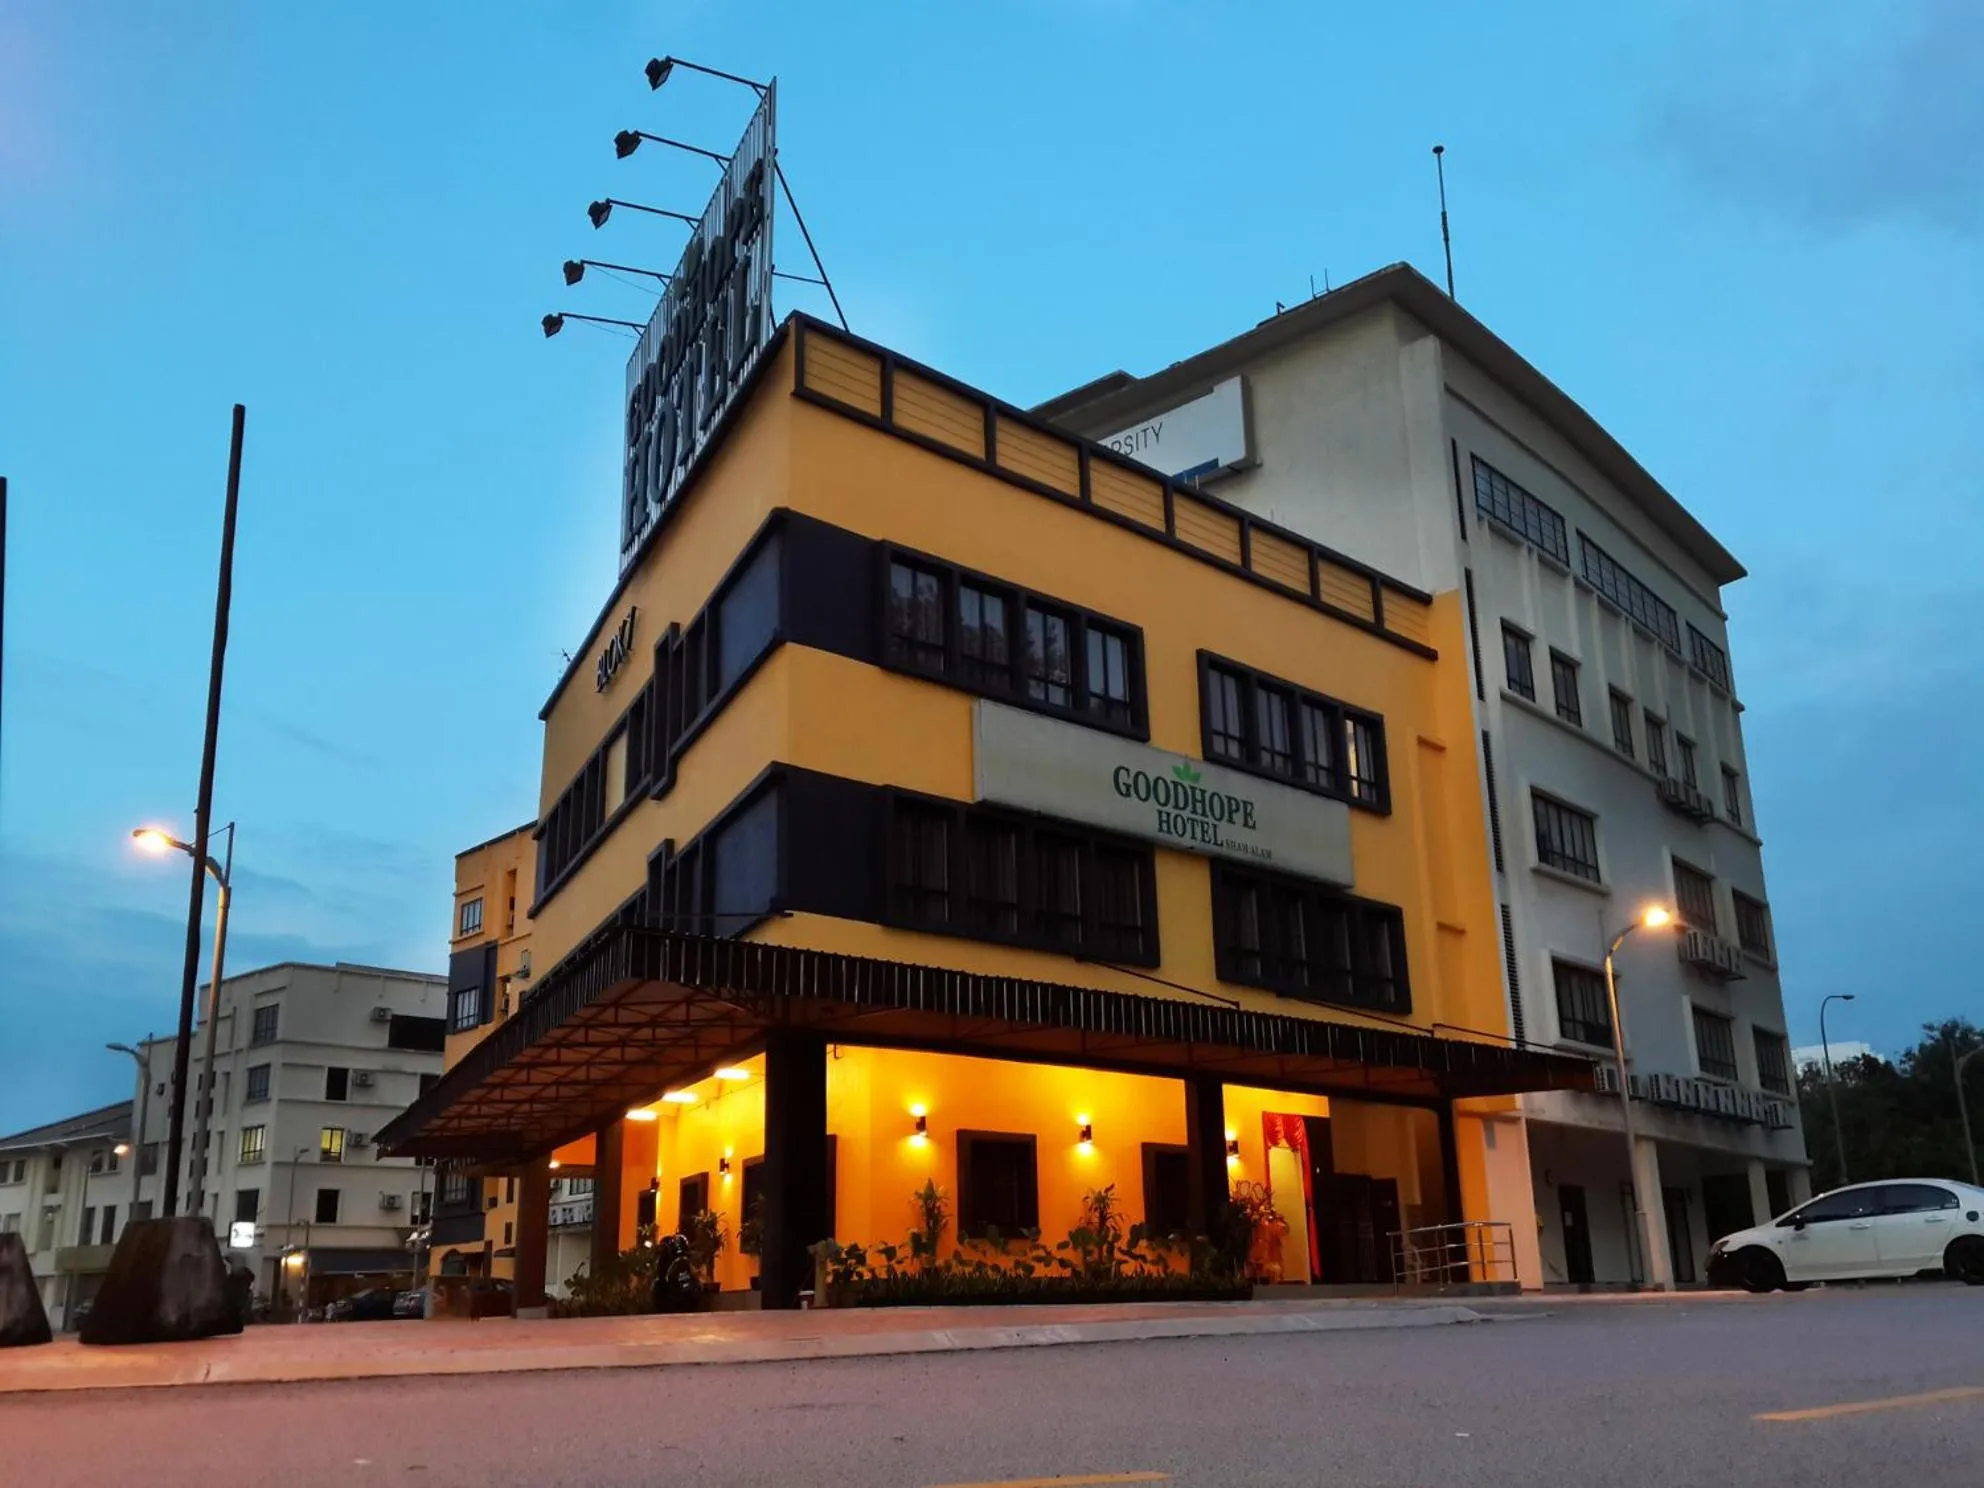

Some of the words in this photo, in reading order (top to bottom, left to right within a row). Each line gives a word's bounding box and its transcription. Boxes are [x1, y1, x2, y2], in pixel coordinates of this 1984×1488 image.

[628, 158, 764, 446] GOODHOPE
[622, 255, 760, 554] HOTEL
[1105, 421, 1163, 456] RSITY
[1113, 766, 1256, 830] GOODHOPE
[1156, 809, 1224, 847] HOTEL
